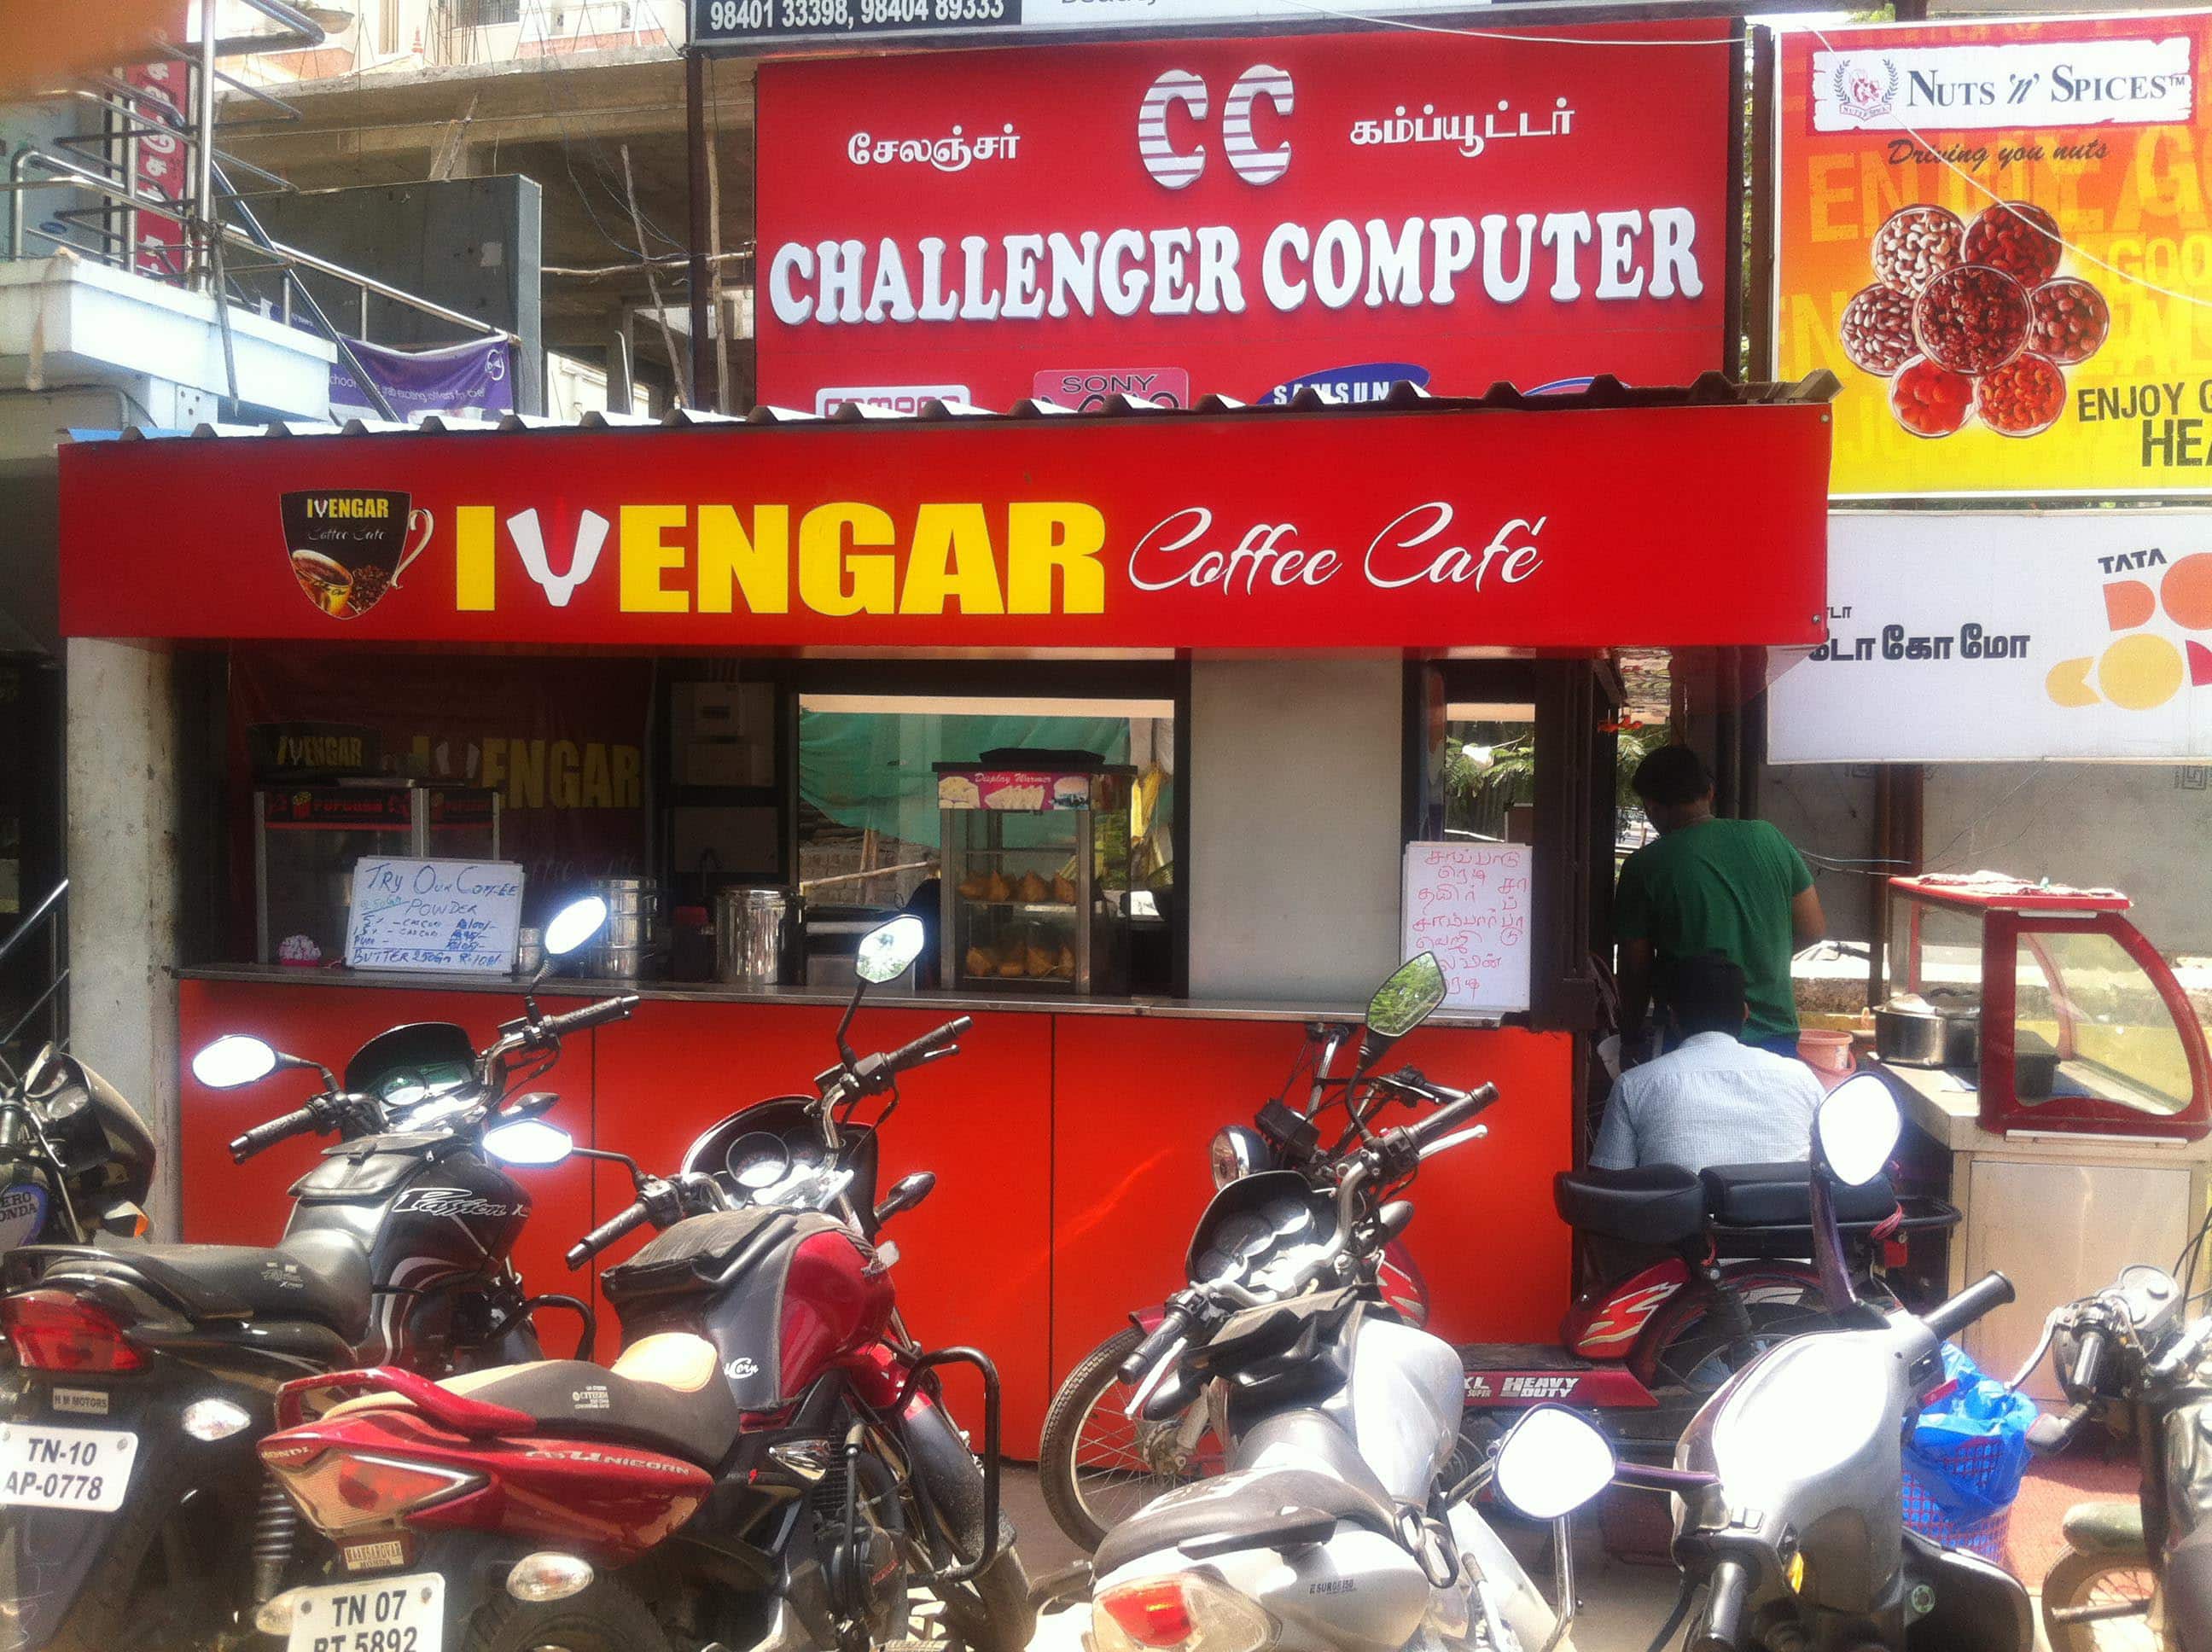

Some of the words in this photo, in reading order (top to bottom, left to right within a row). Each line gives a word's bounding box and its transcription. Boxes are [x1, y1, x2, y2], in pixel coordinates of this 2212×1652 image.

[710, 1, 774, 30] 98401
[860, 0, 929, 23] 98404
[1906, 69, 1995, 107] NUTS
[1348, 96, 1575, 158] கம்ப்யூட்டர்
[847, 123, 1021, 172] சேலஞ்சர்
[1887, 138, 1989, 170] Driving
[1998, 144, 2043, 172] you
[2052, 138, 2108, 161] nuts
[768, 226, 1247, 326] CHALLENGER
[1261, 207, 1704, 312] COMPUTER
[1062, 374, 1157, 393] SONY
[2077, 381, 2186, 422] ENJOY
[2141, 417, 2212, 468] HE
[1127, 506, 1343, 596] Coffee
[2098, 547, 2168, 574] TATA
[974, 772, 1012, 786] Display
[1014, 771, 1052, 784] Warmer
[405, 898, 478, 916] POWDER
[352, 949, 412, 965] BUTTER
[28, 1438, 98, 1467] TN-10
[3, 1470, 104, 1502] AP-0778
[331, 1594, 367, 1627] TN
[375, 1589, 407, 1623] 07
